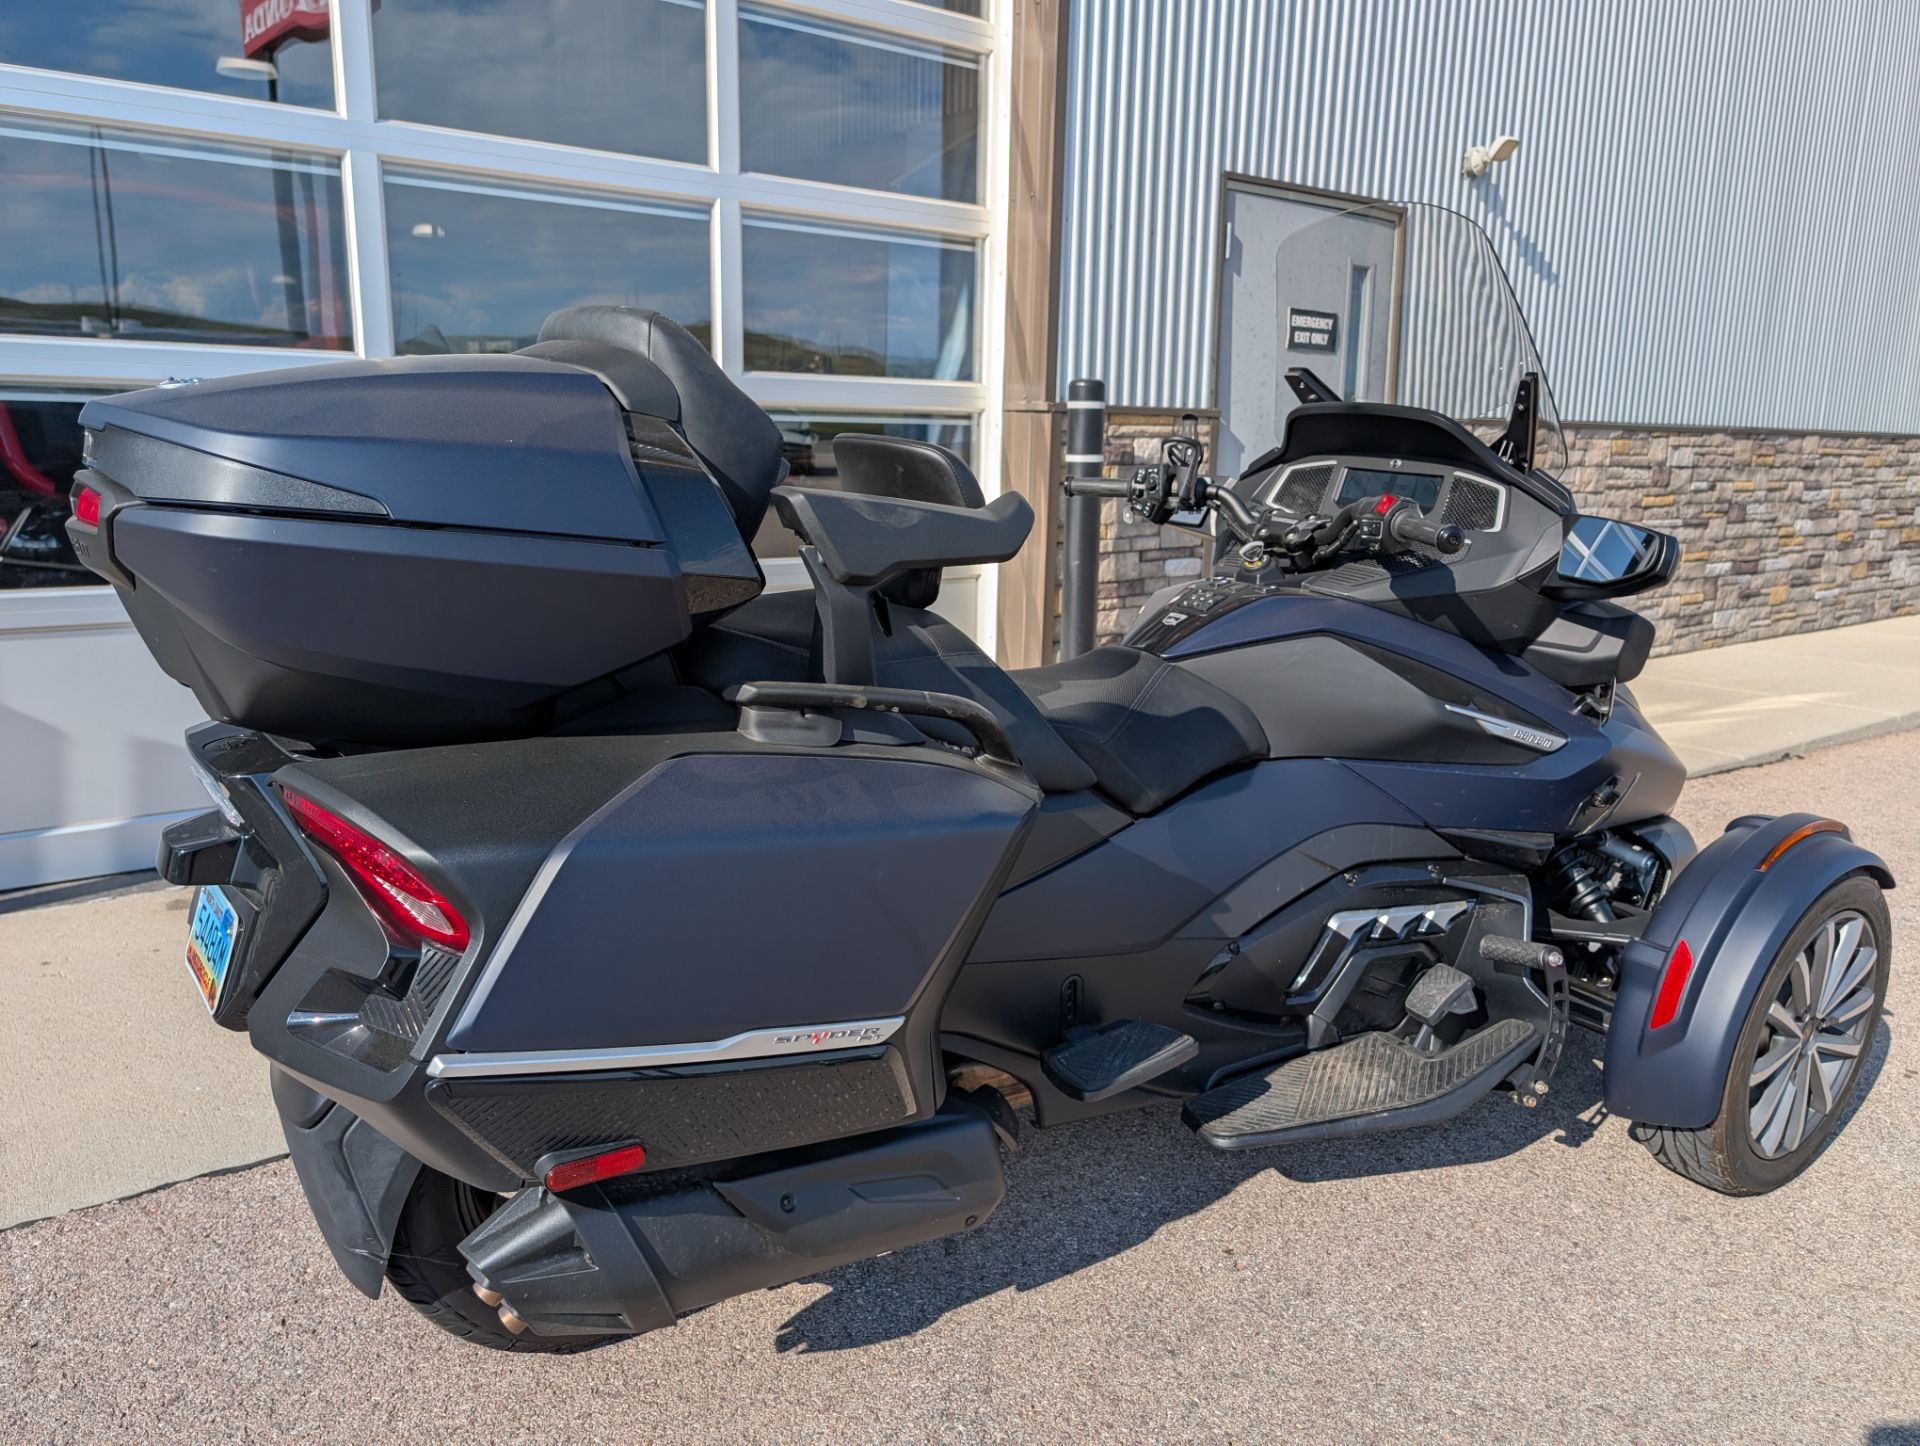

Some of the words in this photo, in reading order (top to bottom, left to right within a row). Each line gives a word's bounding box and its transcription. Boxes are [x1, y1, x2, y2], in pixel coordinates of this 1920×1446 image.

[1291, 314, 1334, 331] EMERGENCY
[1294, 331, 1311, 343] EXIT
[1311, 333, 1329, 345] ONLY
[773, 1027, 881, 1045] SPYDER
